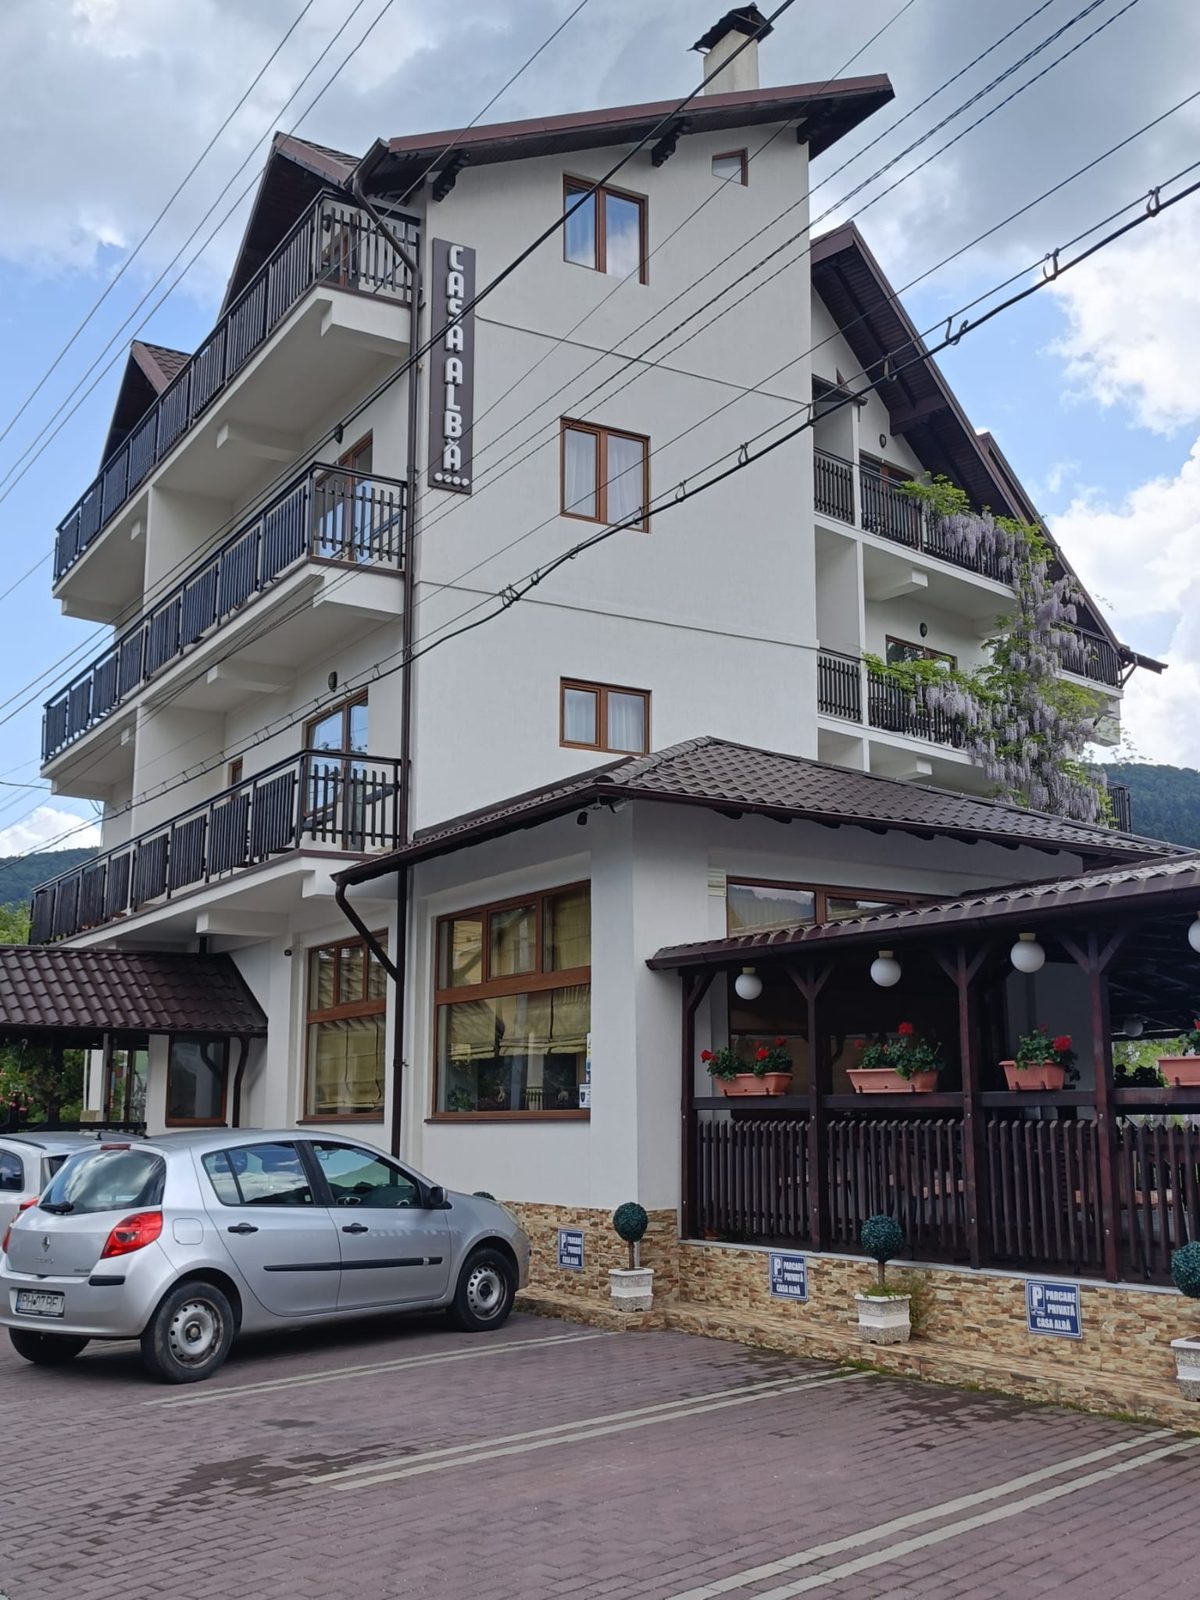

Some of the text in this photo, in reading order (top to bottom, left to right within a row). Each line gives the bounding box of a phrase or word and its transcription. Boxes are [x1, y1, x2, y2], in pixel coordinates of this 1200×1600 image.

[443, 245, 464, 470] CASA ALBĂ
[774, 1258, 781, 1274] P
[1032, 1286, 1042, 1307] P
[1045, 1290, 1076, 1303] PARCARE
[1036, 1317, 1054, 1328] CASA
